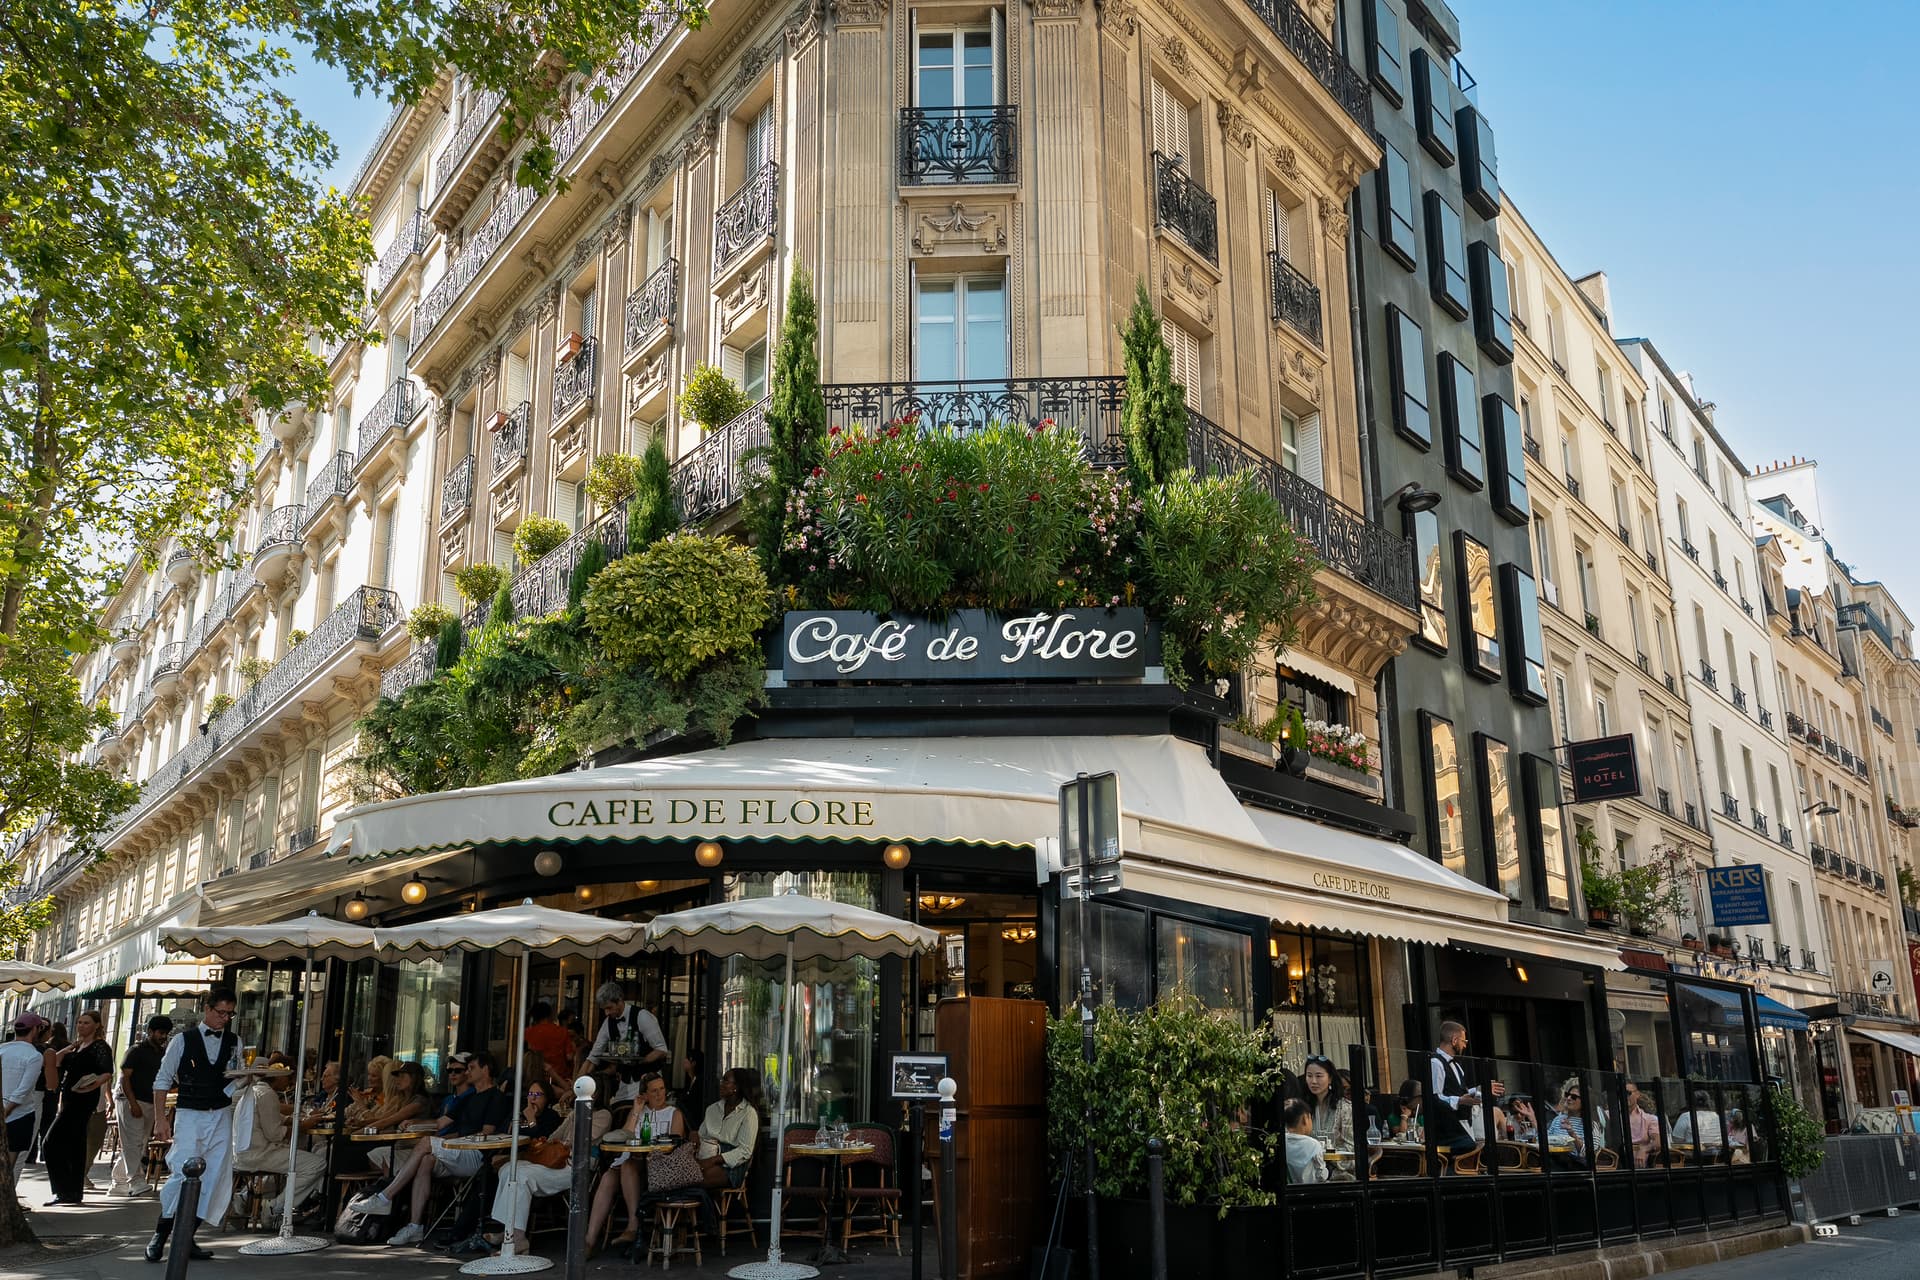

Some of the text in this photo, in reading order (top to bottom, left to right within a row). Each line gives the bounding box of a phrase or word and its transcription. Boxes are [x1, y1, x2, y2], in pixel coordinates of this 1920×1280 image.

[788, 612, 1139, 674] Café de Flore
[1584, 770, 1626, 784] HOTEL
[548, 799, 875, 827] CAFE DE FLORE
[1313, 872, 1390, 900] CAFE DE FLORE
[1710, 868, 1761, 888] KBG
